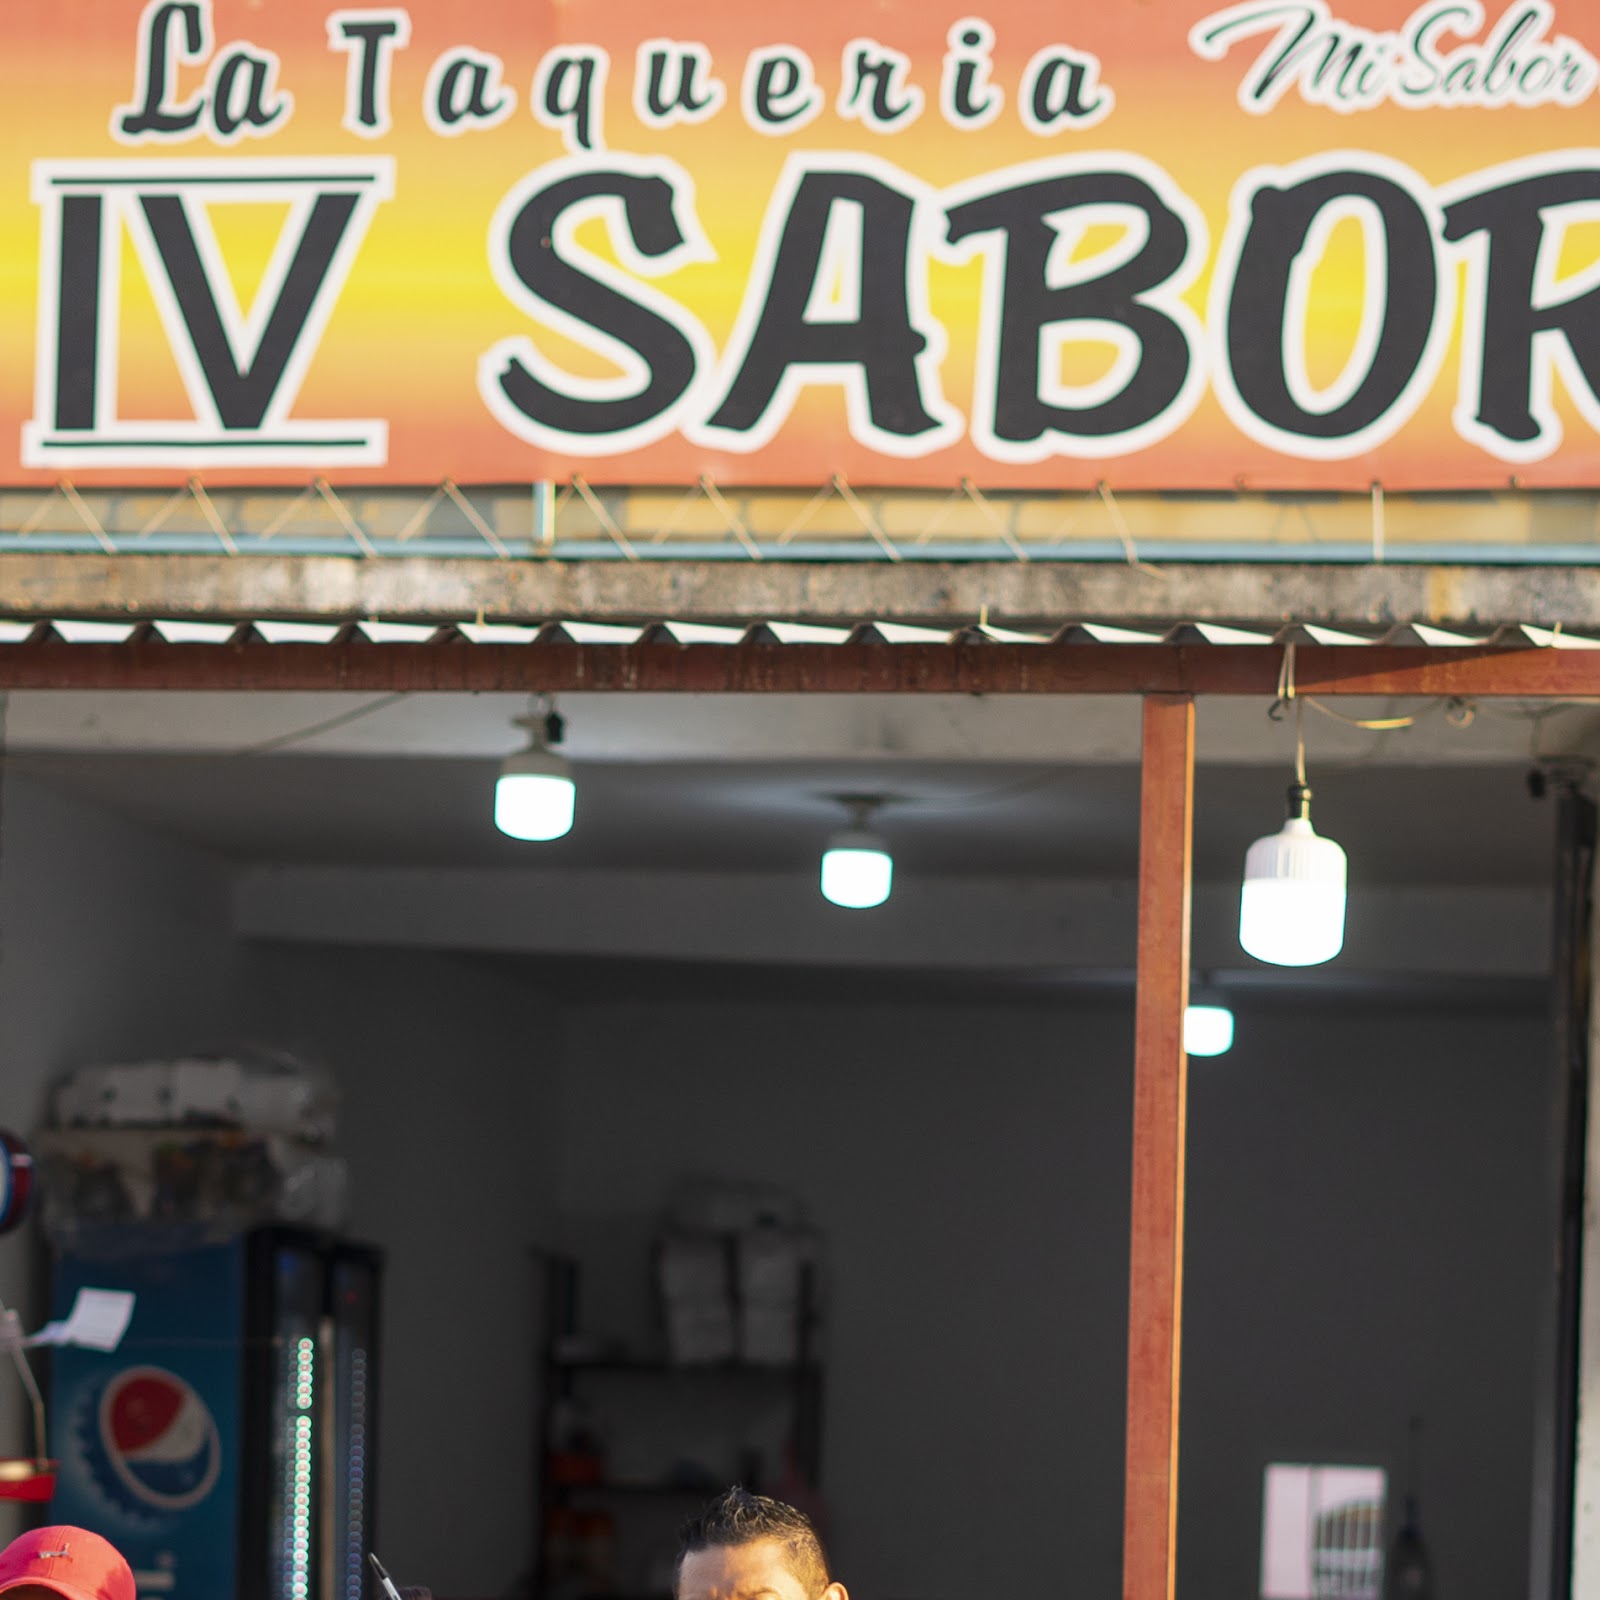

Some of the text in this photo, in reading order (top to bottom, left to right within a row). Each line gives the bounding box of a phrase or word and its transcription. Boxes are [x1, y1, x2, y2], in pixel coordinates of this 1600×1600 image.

[122, 2, 1105, 149] La Taqueria
[1202, 5, 1387, 100] Mi
[1399, 5, 1584, 97] Sabor
[44, 174, 376, 447] IV
